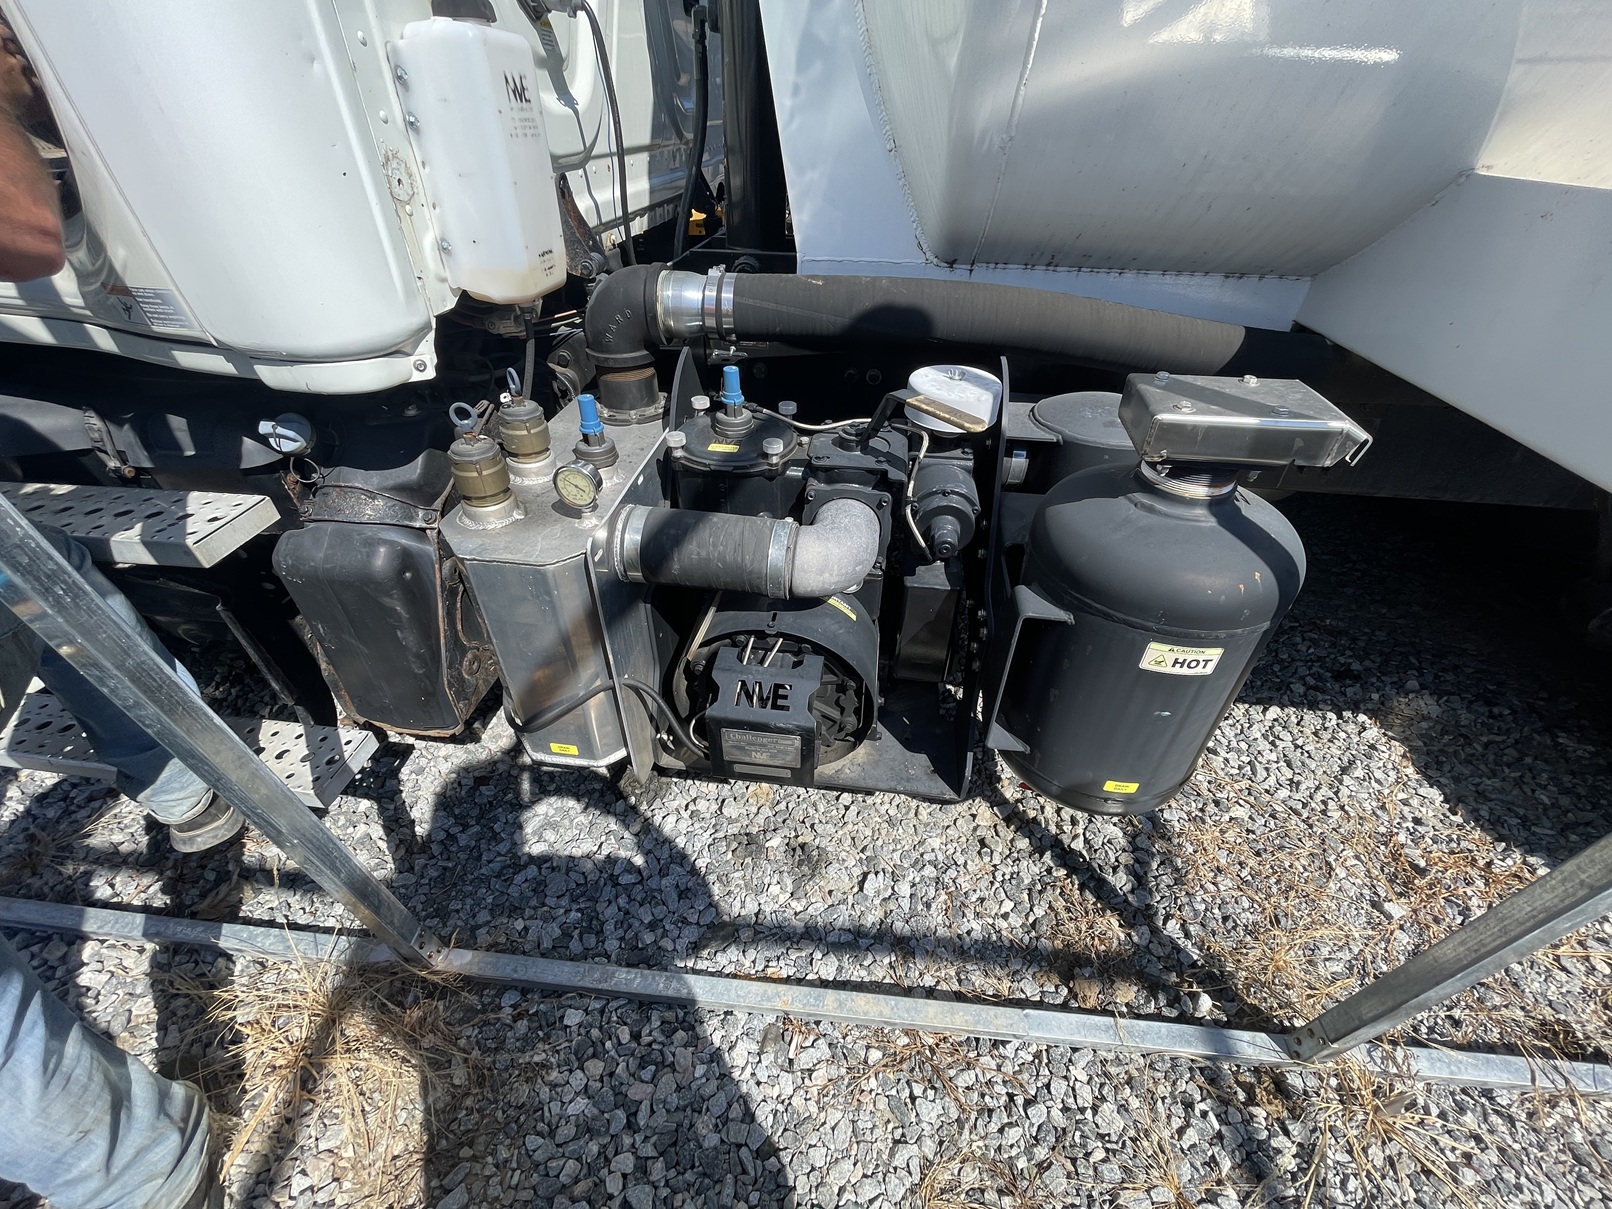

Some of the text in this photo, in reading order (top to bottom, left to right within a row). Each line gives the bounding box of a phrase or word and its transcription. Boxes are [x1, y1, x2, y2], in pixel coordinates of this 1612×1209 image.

[503, 70, 532, 104] NVE
[605, 308, 632, 342] WARD
[1171, 657, 1214, 669] HOT
[735, 679, 793, 712] NVE
[729, 732, 779, 744] Challenger
